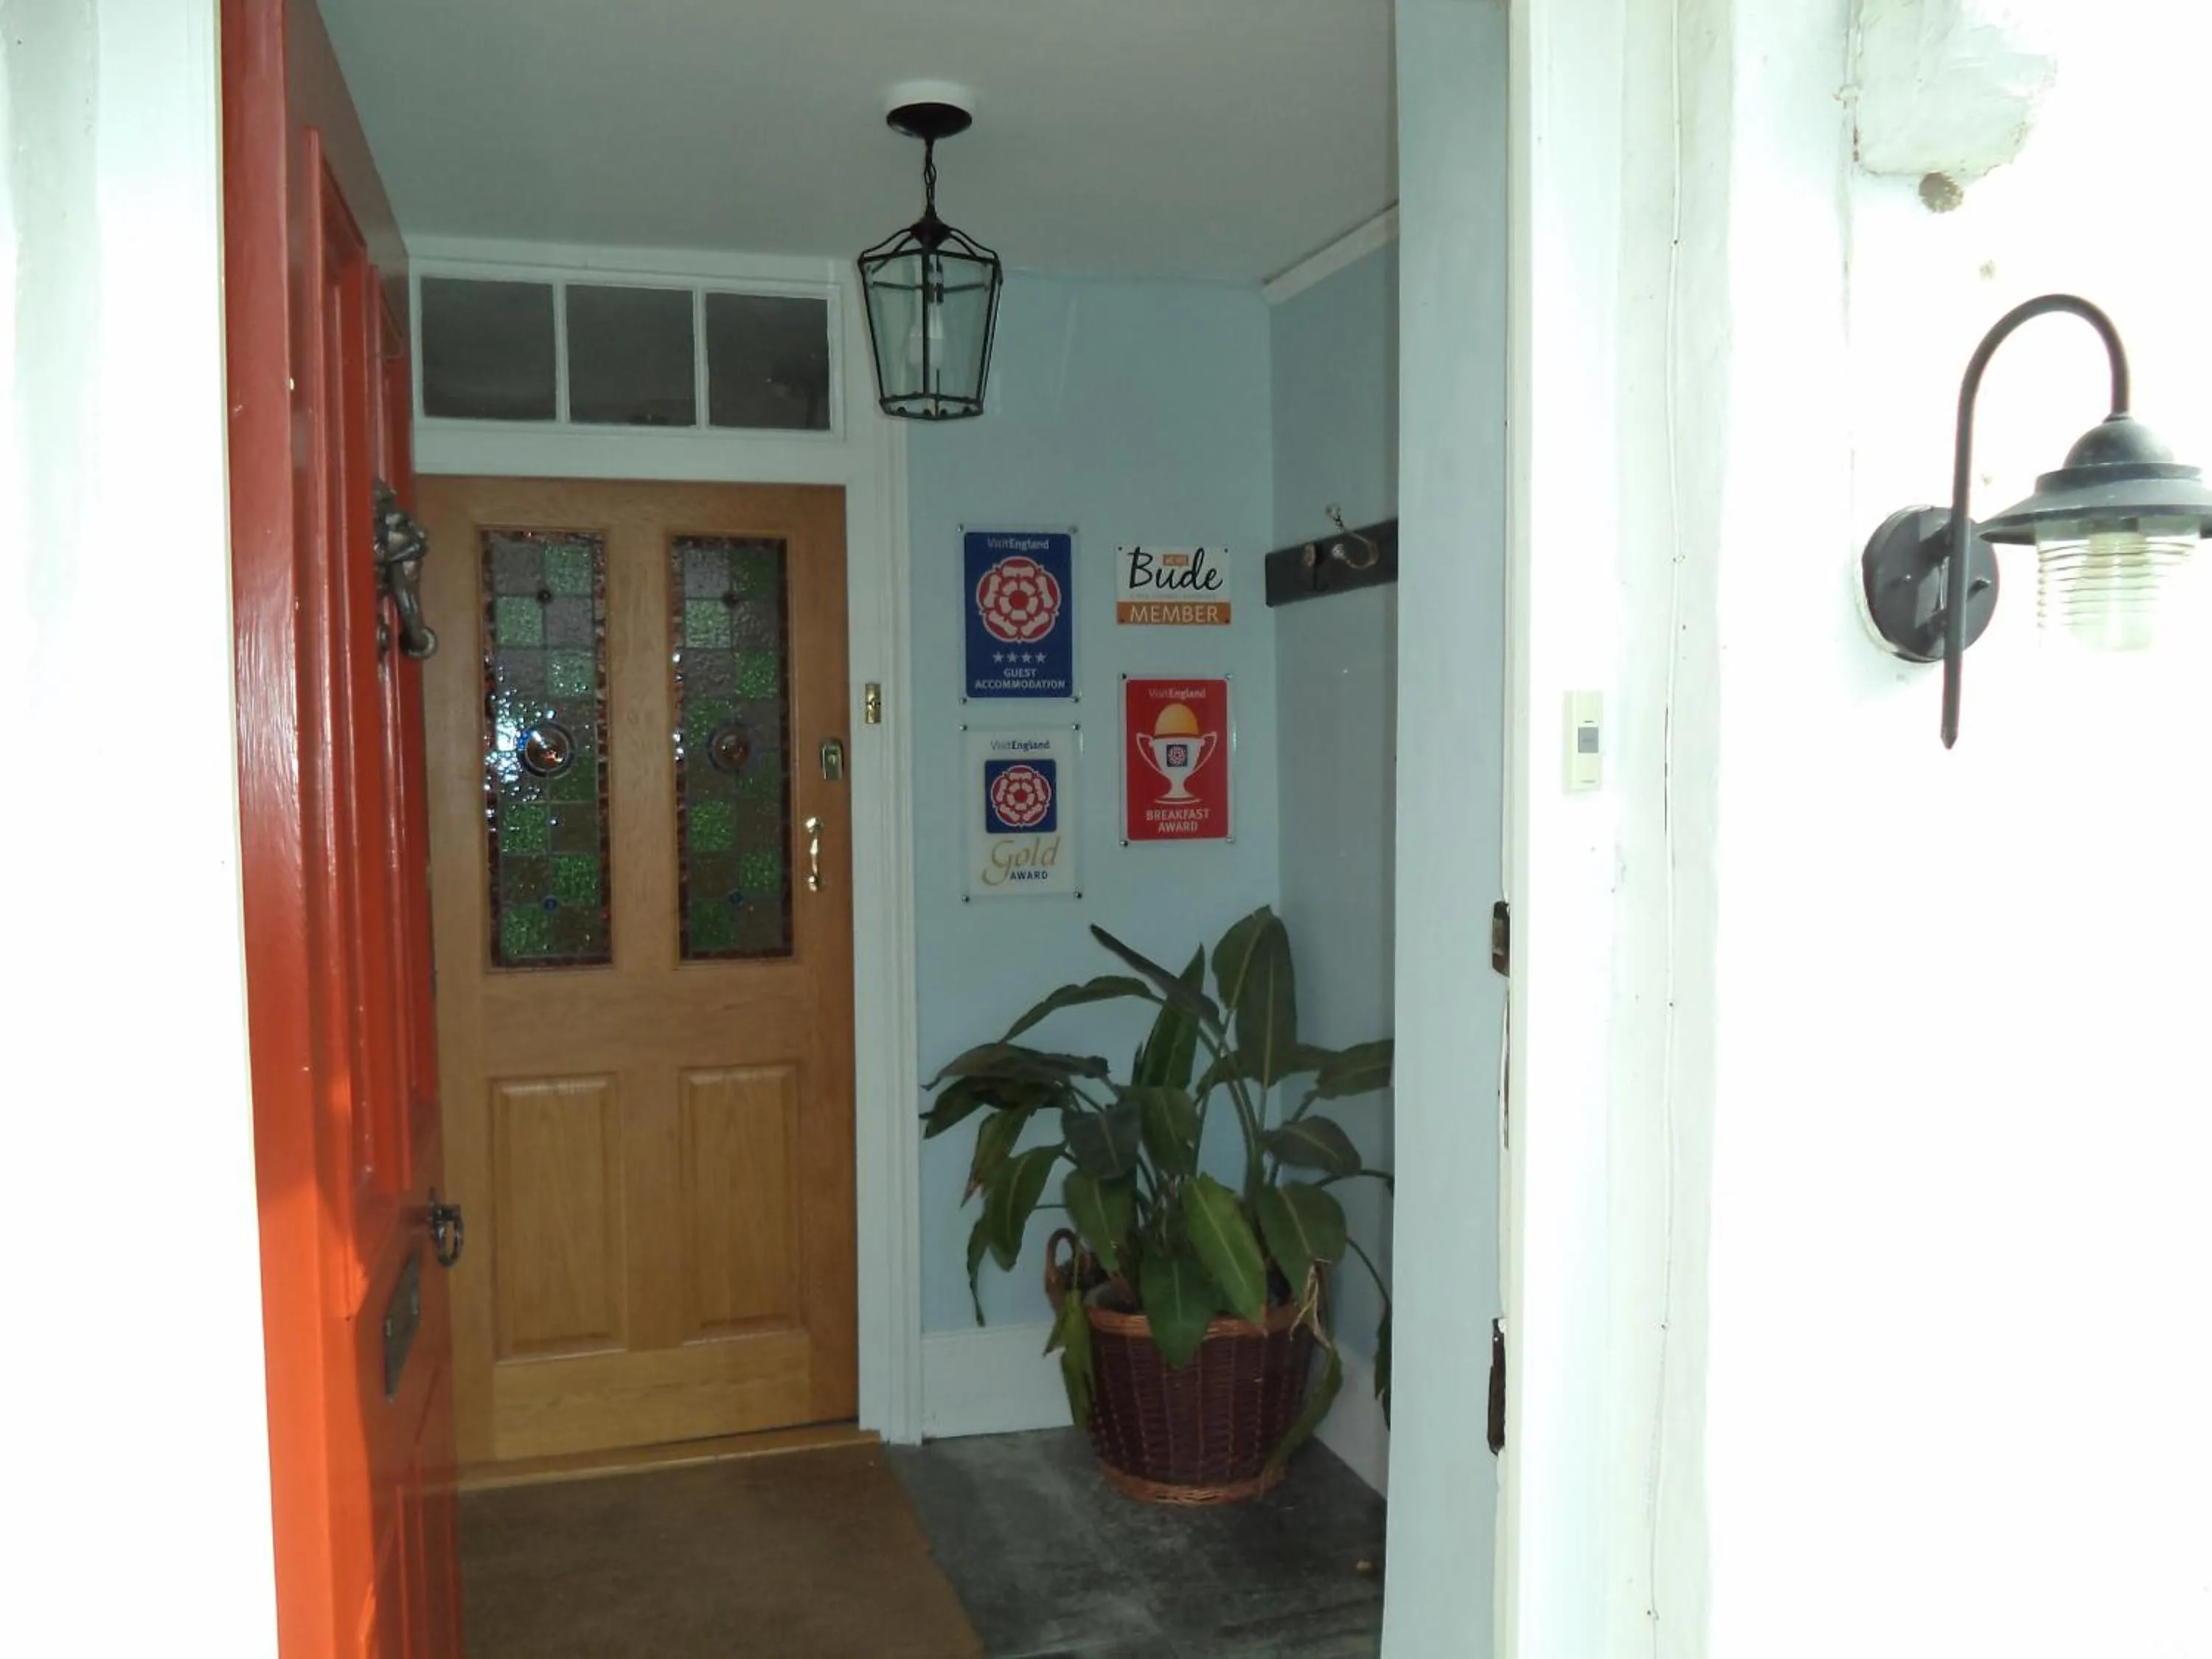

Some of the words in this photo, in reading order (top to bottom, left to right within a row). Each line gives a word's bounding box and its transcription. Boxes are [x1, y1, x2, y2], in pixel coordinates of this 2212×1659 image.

[987, 538, 1049, 550] VisitEngland
[1127, 546, 1223, 591] Bude
[1130, 605, 1220, 623] MEMBER
[1004, 667, 1037, 678] GUEST
[975, 679, 1065, 689] ACCOMMODATION
[1148, 687, 1206, 699] VisitEngland
[990, 740, 1051, 752] VisitEngland
[1146, 808, 1209, 821] BREAKFAST
[1158, 821, 1199, 832] AWARD
[981, 835, 1061, 886] Gold
[1009, 870, 1048, 880] AWARD
